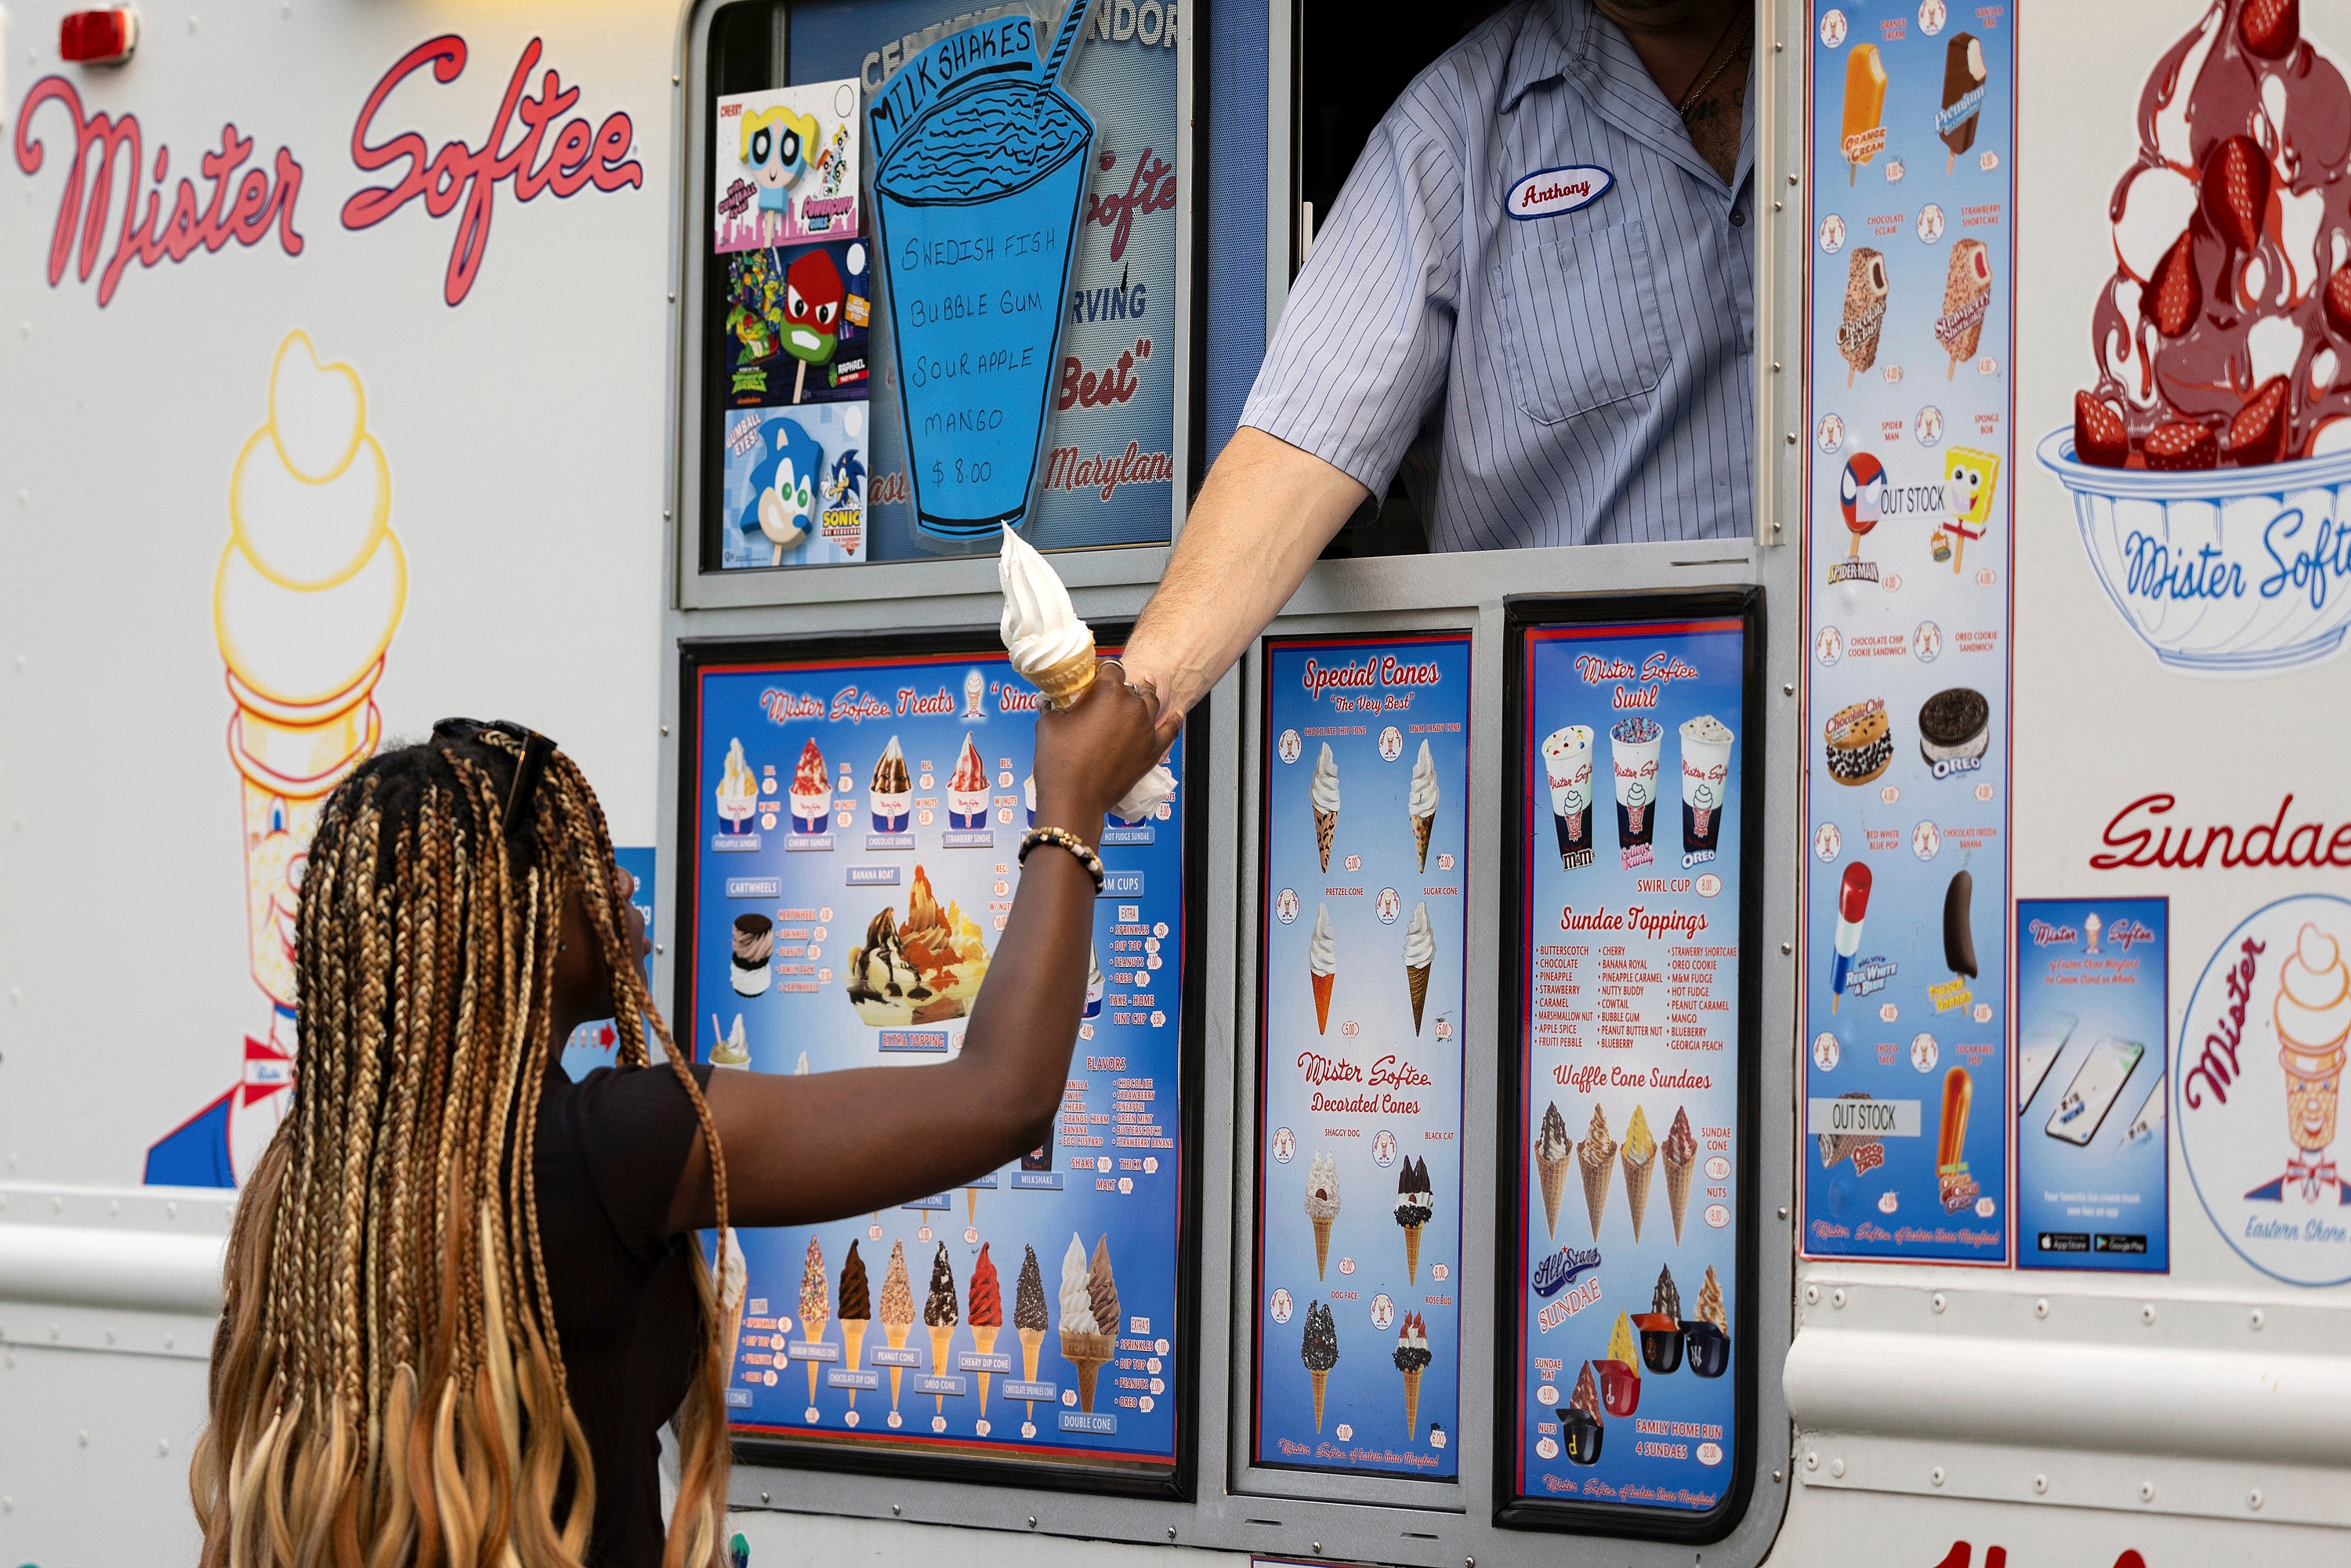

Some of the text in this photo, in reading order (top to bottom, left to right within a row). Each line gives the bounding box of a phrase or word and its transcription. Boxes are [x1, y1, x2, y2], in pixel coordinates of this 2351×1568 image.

[1880, 18, 1907, 30] ORANGE
[1882, 30, 1905, 41] CREAM
[870, 56, 937, 157] MILK
[939, 20, 1031, 79] SHAKES
[14, 34, 643, 309] Mister Softee
[1522, 180, 1591, 207] Anthony
[1961, 204, 2001, 215] STRAWBERRY
[1867, 214, 1904, 225] CHOCOLATE
[1962, 215, 1999, 227] SHORTCAKE
[1875, 226, 1896, 236] ECLAIR
[1004, 227, 1055, 258] FISH
[910, 290, 1042, 328] BUBBLE GUM
[1070, 284, 1147, 324] RVING
[838, 358, 866, 375] RAPHAEL
[912, 346, 1034, 388] SOUR APPLE
[925, 409, 1003, 436] MANGO
[726, 412, 763, 448] GUMBALL
[734, 429, 759, 458] EYES!
[955, 458, 991, 483] 8.00
[1042, 440, 1172, 501] Marylan
[1880, 485, 1945, 514] OUT STOCK
[822, 509, 860, 528] SONIC
[2125, 509, 2351, 609] Mister Soft
[1828, 562, 1879, 585] SPIDER-MAN
[1850, 636, 1904, 646] CHOCOLATE CHIP
[1955, 631, 1998, 641] OREO COOKIE
[1848, 646, 1906, 657] COOKIE SANDWICH
[1575, 653, 1698, 684] Mister Softee
[1303, 657, 1440, 699] Special Cones
[1613, 685, 1658, 708] Swirl
[761, 687, 955, 723] Mister Softee Treats
[1357, 697, 1382, 715] Very
[1304, 726, 1367, 736] CHOCOLATE CHIP CONE
[1409, 723, 1461, 733] M&M CANDY CONE
[1932, 755, 1980, 780] OREO
[945, 834, 991, 843] STRAWBERRY SUNDAE
[1131, 831, 1150, 840] SUNDAE
[1348, 857, 1358, 869] 5.00
[1682, 849, 1715, 869] OREO
[853, 870, 893, 880] BANANA BOAT
[730, 882, 777, 893] CARTWHEELS
[1637, 879, 1690, 893] SWIRL CUP
[1701, 878, 1712, 891] 8.00
[1560, 906, 1708, 940] Sundae Toppings
[1115, 925, 1150, 936] SPRINKLES
[2030, 918, 2076, 947] Mister
[1540, 946, 1589, 955] BUTTERSCOTCH
[1603, 947, 1625, 956] CHERRY
[1672, 947, 1737, 957] STRAWERRY SHORTCAKE
[1540, 959, 1578, 969] CHOCOLATE
[1603, 959, 1647, 969] BANANA ROYAL
[1672, 960, 1717, 970] OREO COOKIE
[1540, 972, 1573, 981] PINEAPPLE
[1602, 972, 1663, 983] PINEAPPLE CARAMEL
[1602, 999, 1629, 1009] COWTAIL
[2185, 936, 2266, 1110] Mister
[882, 1034, 944, 1048] EXTRA TOPPING
[1538, 1037, 1582, 1048] FRUITI PEBBLE
[1671, 1040, 1723, 1051] GEORGIA PEACH
[1086, 1057, 1126, 1071] FLAVORS
[1298, 1052, 1432, 1090] Mister Softee
[1118, 1078, 1154, 1088] CHOCOLATE
[1553, 1064, 1712, 1094] Waffle Cone Sundaes
[1311, 1092, 1421, 1114] Decorated Cones
[1063, 1114, 1109, 1124] ORANGE CREAM
[1833, 1104, 1896, 1130] OUT STOCK
[1117, 1126, 1162, 1136] BUTTERSCOTCH
[1325, 1128, 1360, 1138] SHAGGY DOG
[1701, 1127, 1731, 1138] SUNDAE
[1707, 1140, 1728, 1151] CONE
[1071, 1158, 1094, 1169] SHAKE
[1021, 1175, 1053, 1184] MILKSHAKE
[1096, 1179, 1116, 1190] MALT
[1707, 1187, 1726, 1198] NUTS
[2244, 1215, 2346, 1242] Eastern Shore
[1342, 1259, 1353, 1272] 6.00
[1331, 1291, 1357, 1300] DOG FACE
[1425, 1296, 1452, 1305] ROSE BUD
[1538, 1278, 1602, 1333] SUNDAE
[1120, 1340, 1154, 1351] SPRINKLES
[961, 1357, 1009, 1369] CHERRY DIP CONE
[1535, 1358, 1562, 1370] SUNDAE
[1541, 1371, 1555, 1381] HAT
[1064, 1415, 1111, 1430] DOUBLE CONE
[1636, 1420, 1722, 1439] FAMILY HOME RUN
[1278, 1439, 1438, 1468] Mister Softee of Eastern Shore Maryland
[1636, 1443, 1687, 1459] 4 SUNDAES
